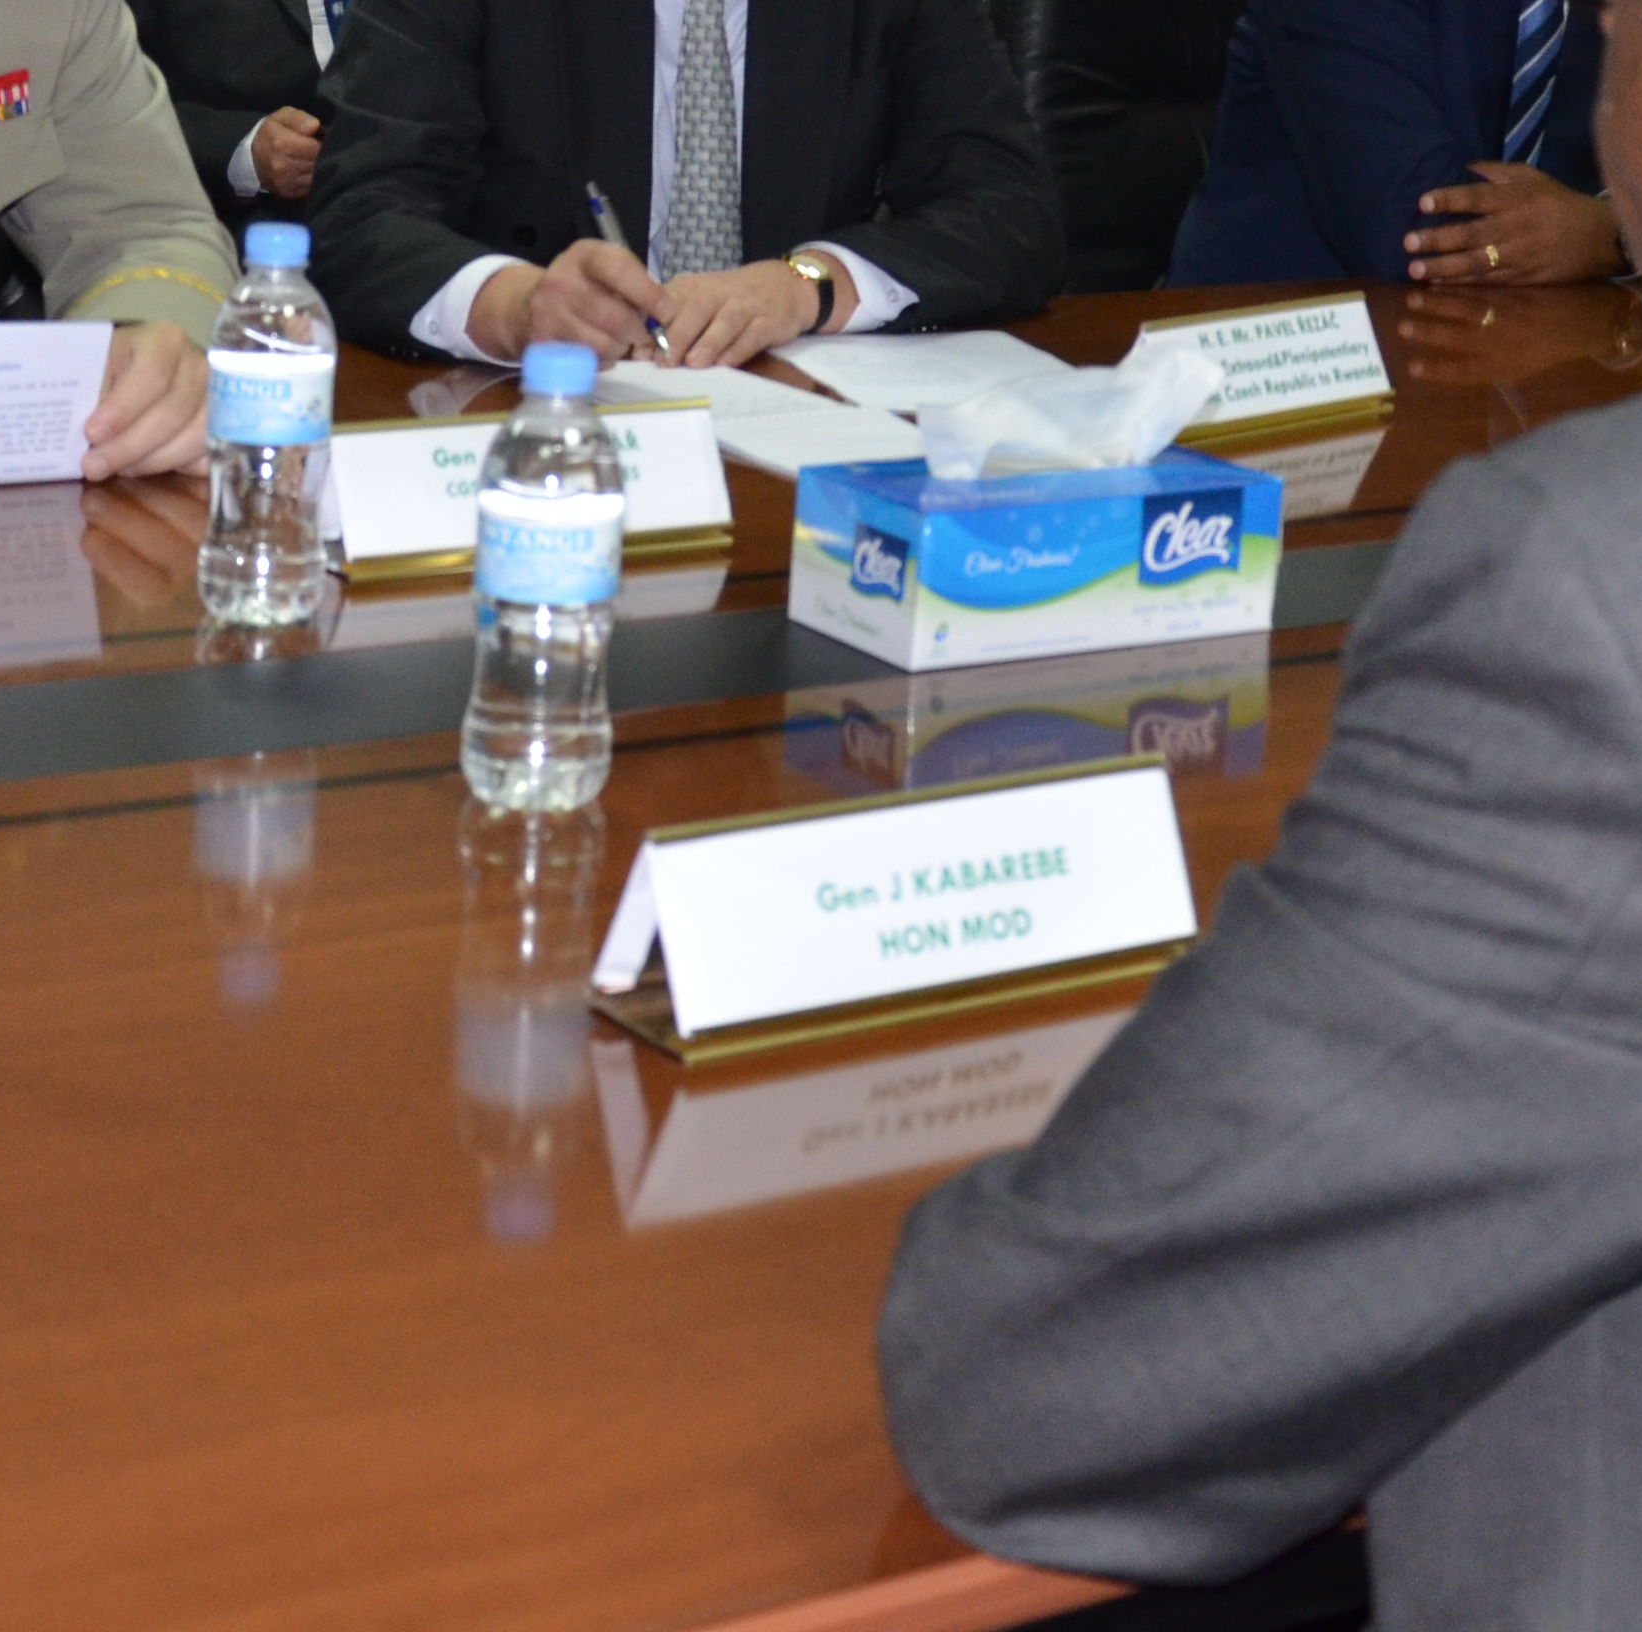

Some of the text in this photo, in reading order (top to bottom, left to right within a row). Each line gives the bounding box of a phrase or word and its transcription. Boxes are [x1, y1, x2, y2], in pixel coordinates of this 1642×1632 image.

[1255, 318, 1296, 340] PAVEL
[1224, 382, 1262, 403] Czech
[1264, 373, 1317, 397] Republic
[1333, 363, 1382, 383] Rwanda
[432, 446, 477, 469] Gen
[1143, 501, 1234, 573] Clear
[815, 845, 1070, 913] Gen J KABAREBE
[877, 907, 1032, 960] HON MOD
